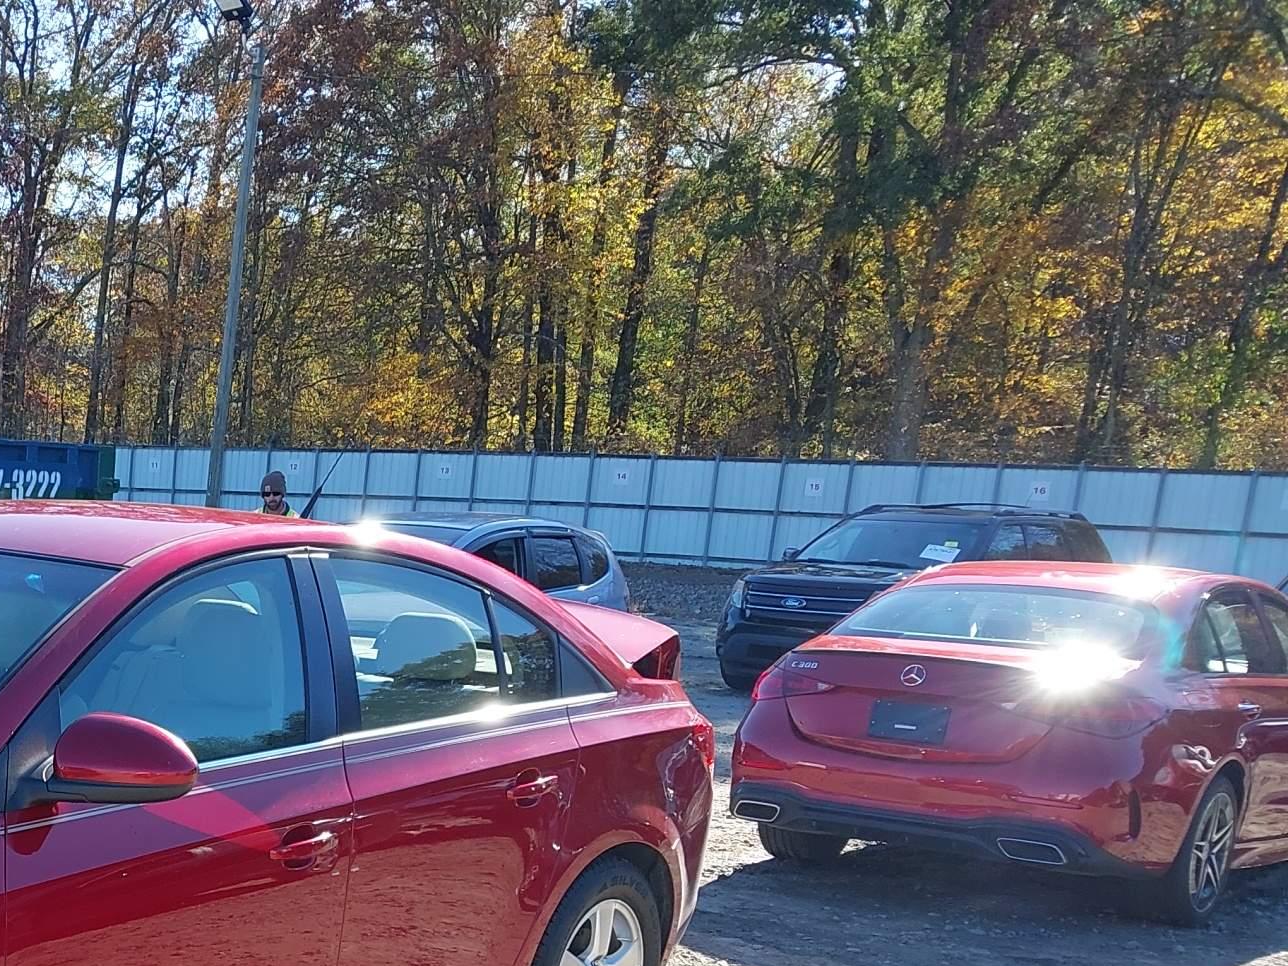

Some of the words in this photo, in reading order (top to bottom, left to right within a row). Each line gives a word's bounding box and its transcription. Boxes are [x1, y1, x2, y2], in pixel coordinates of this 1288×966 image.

[440, 466, 450, 474] 13
[617, 472, 627, 480] 14
[809, 483, 820, 491] 15
[1033, 486, 1047, 495] 16
